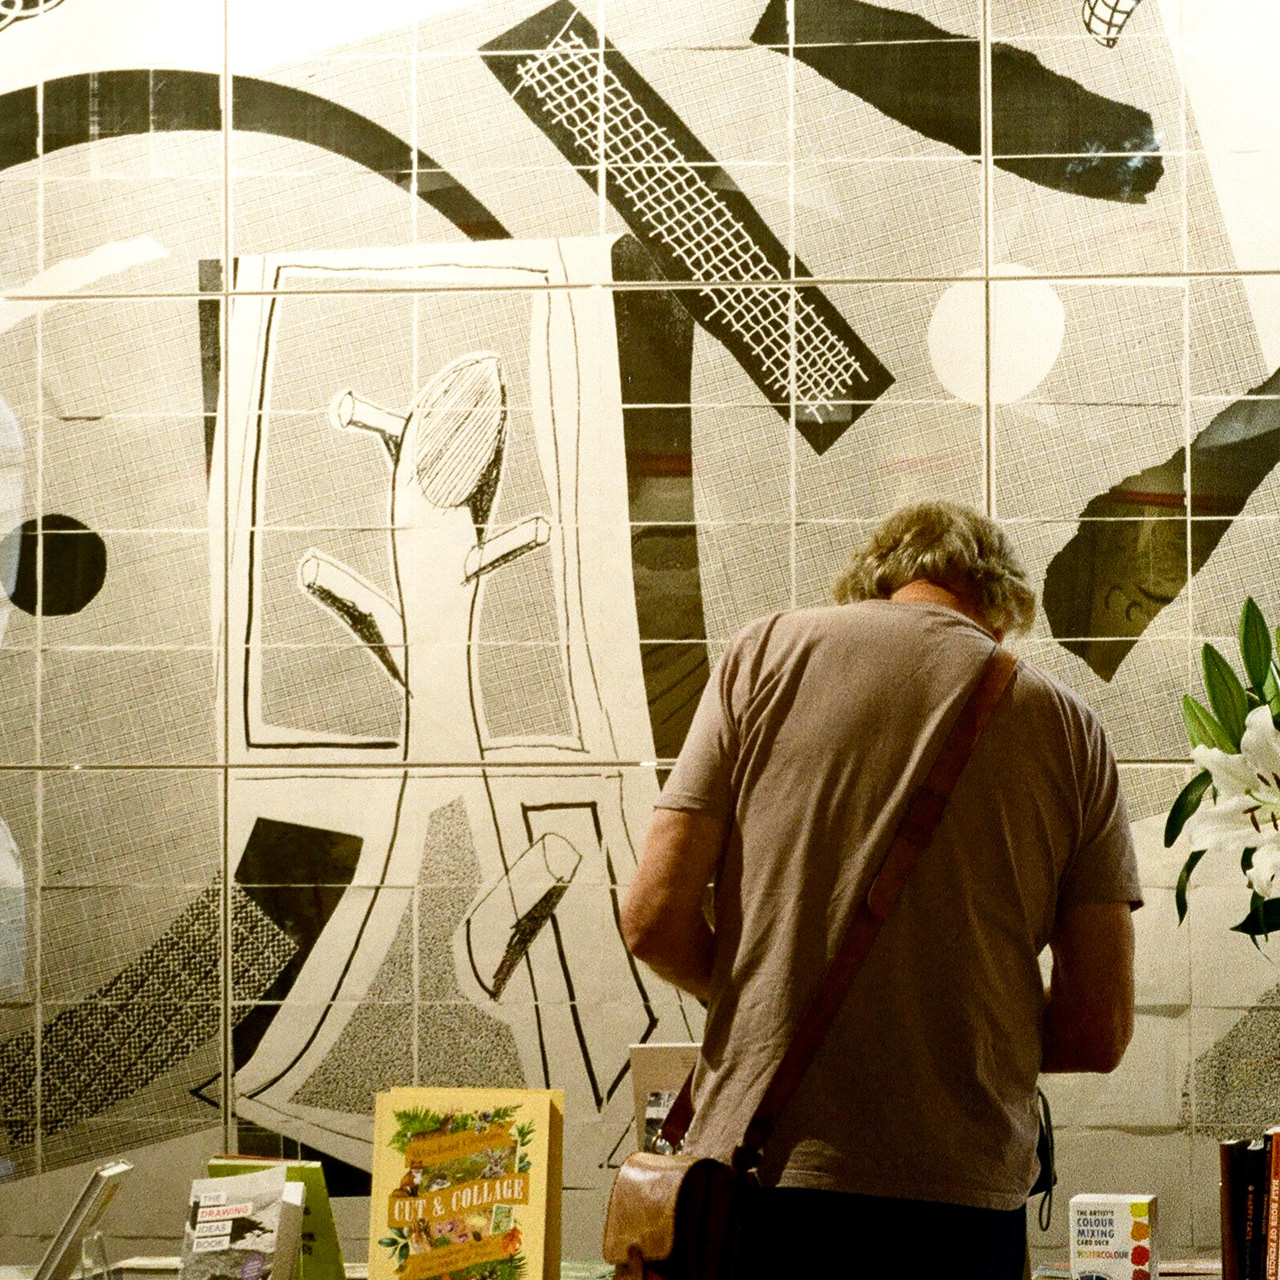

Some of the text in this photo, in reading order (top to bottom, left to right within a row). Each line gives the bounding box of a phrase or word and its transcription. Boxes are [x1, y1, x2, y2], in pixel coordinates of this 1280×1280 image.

[1271, 1179, 1280, 1201] HALF
[203, 1195, 221, 1203] THE
[394, 1178, 524, 1221] CUT & COLLAGE
[200, 1207, 249, 1218] DRAWING
[1246, 1194, 1254, 1220] HAPPY
[1270, 1202, 1278, 1226] HOUR
[198, 1224, 228, 1233] IDEAS
[1076, 1218, 1115, 1228] COLOUR
[1077, 1229, 1115, 1239] MIXING
[1245, 1222, 1253, 1241] CATS
[1269, 1228, 1277, 1242] OF
[196, 1239, 225, 1249] BOOK
[1077, 1251, 1129, 1259] WATERCOLOUR
[1268, 1242, 1277, 1275] PENCIL
